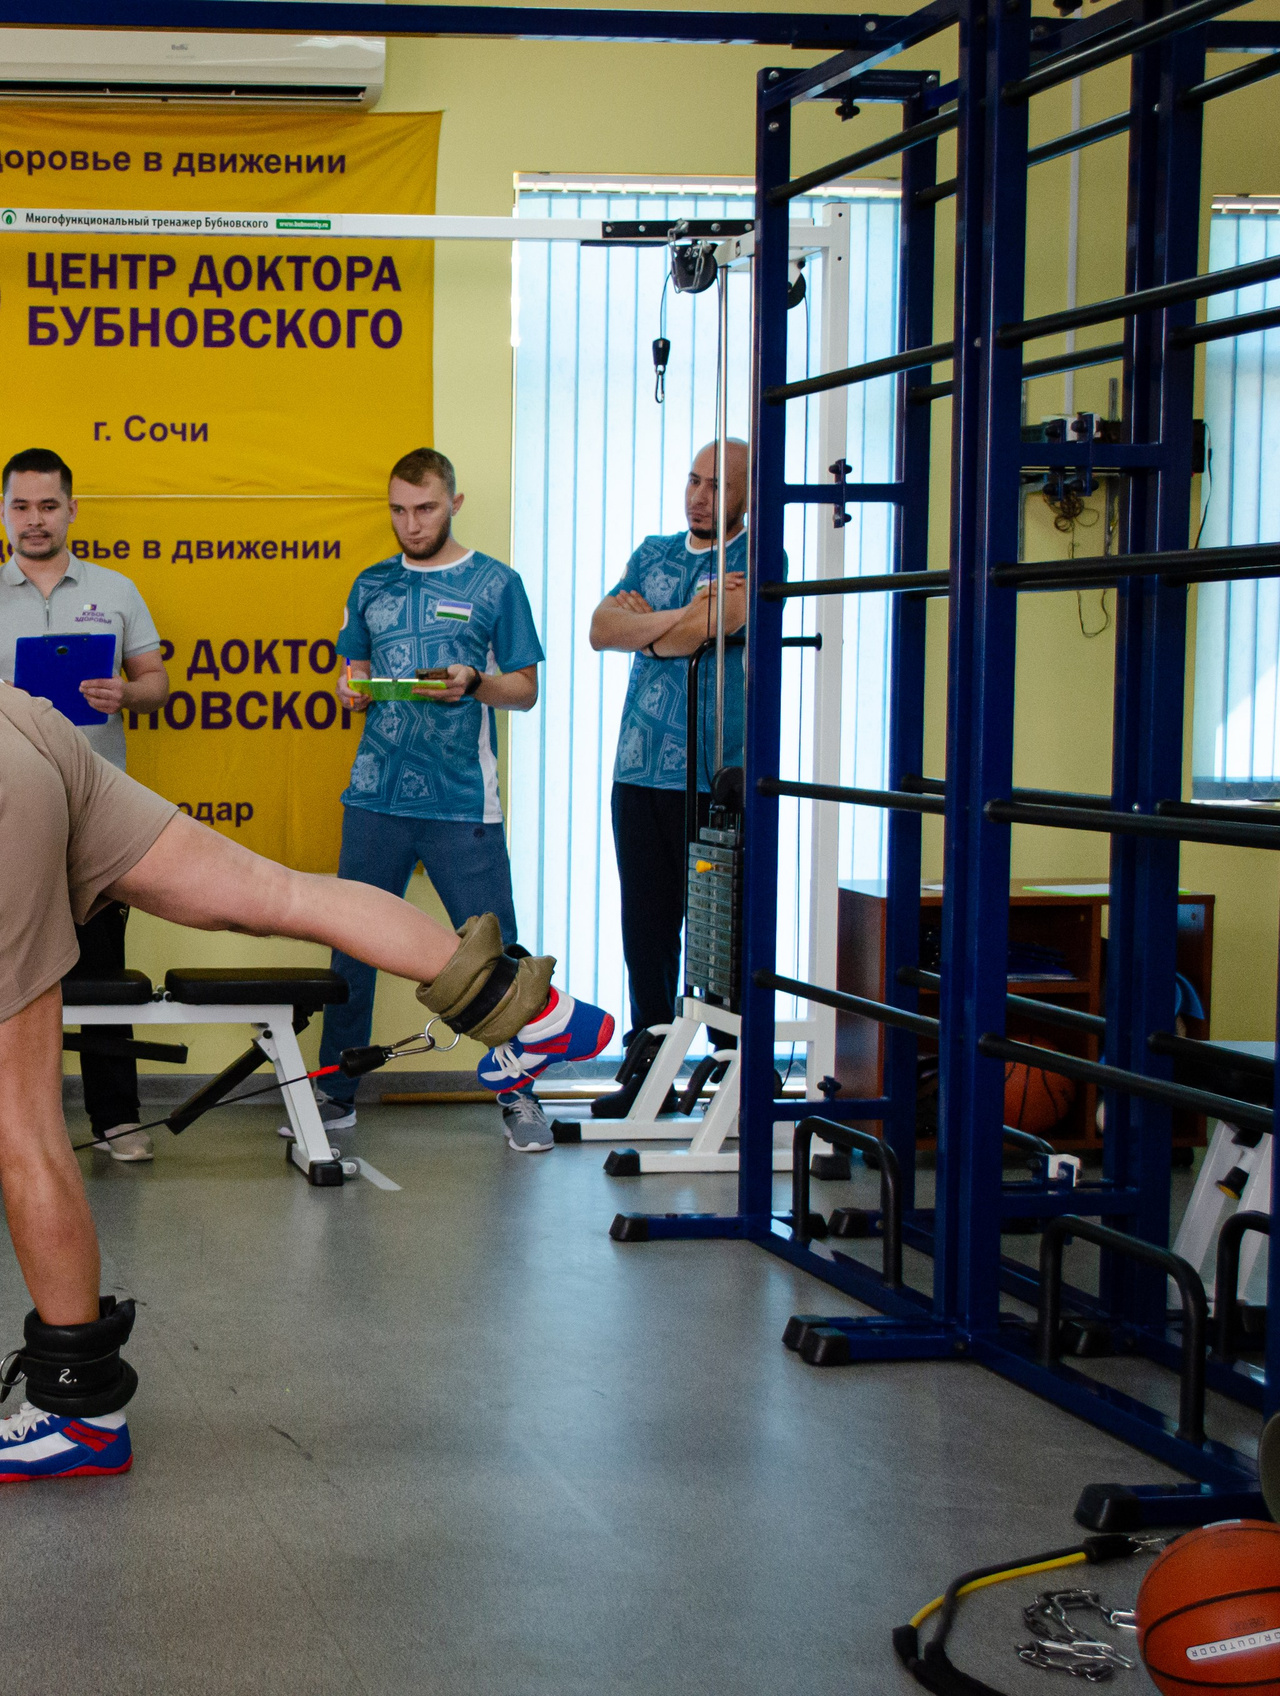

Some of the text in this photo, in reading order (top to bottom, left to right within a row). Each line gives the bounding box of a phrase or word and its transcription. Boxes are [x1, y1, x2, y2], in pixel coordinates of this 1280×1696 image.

[143, 151, 163, 172] в
[172, 152, 346, 177] движении
[25, 212, 269, 230] Многофункциональный тренажер Бубновского
[27, 252, 402, 298] ЦЕНТР ДОКТОРА
[28, 306, 403, 349] БУБНОВСКОГО
[94, 415, 208, 442] г. Сочи
[143, 540, 161, 559] в
[171, 540, 341, 564] движении
[186, 638, 337, 681] ДОКТО
